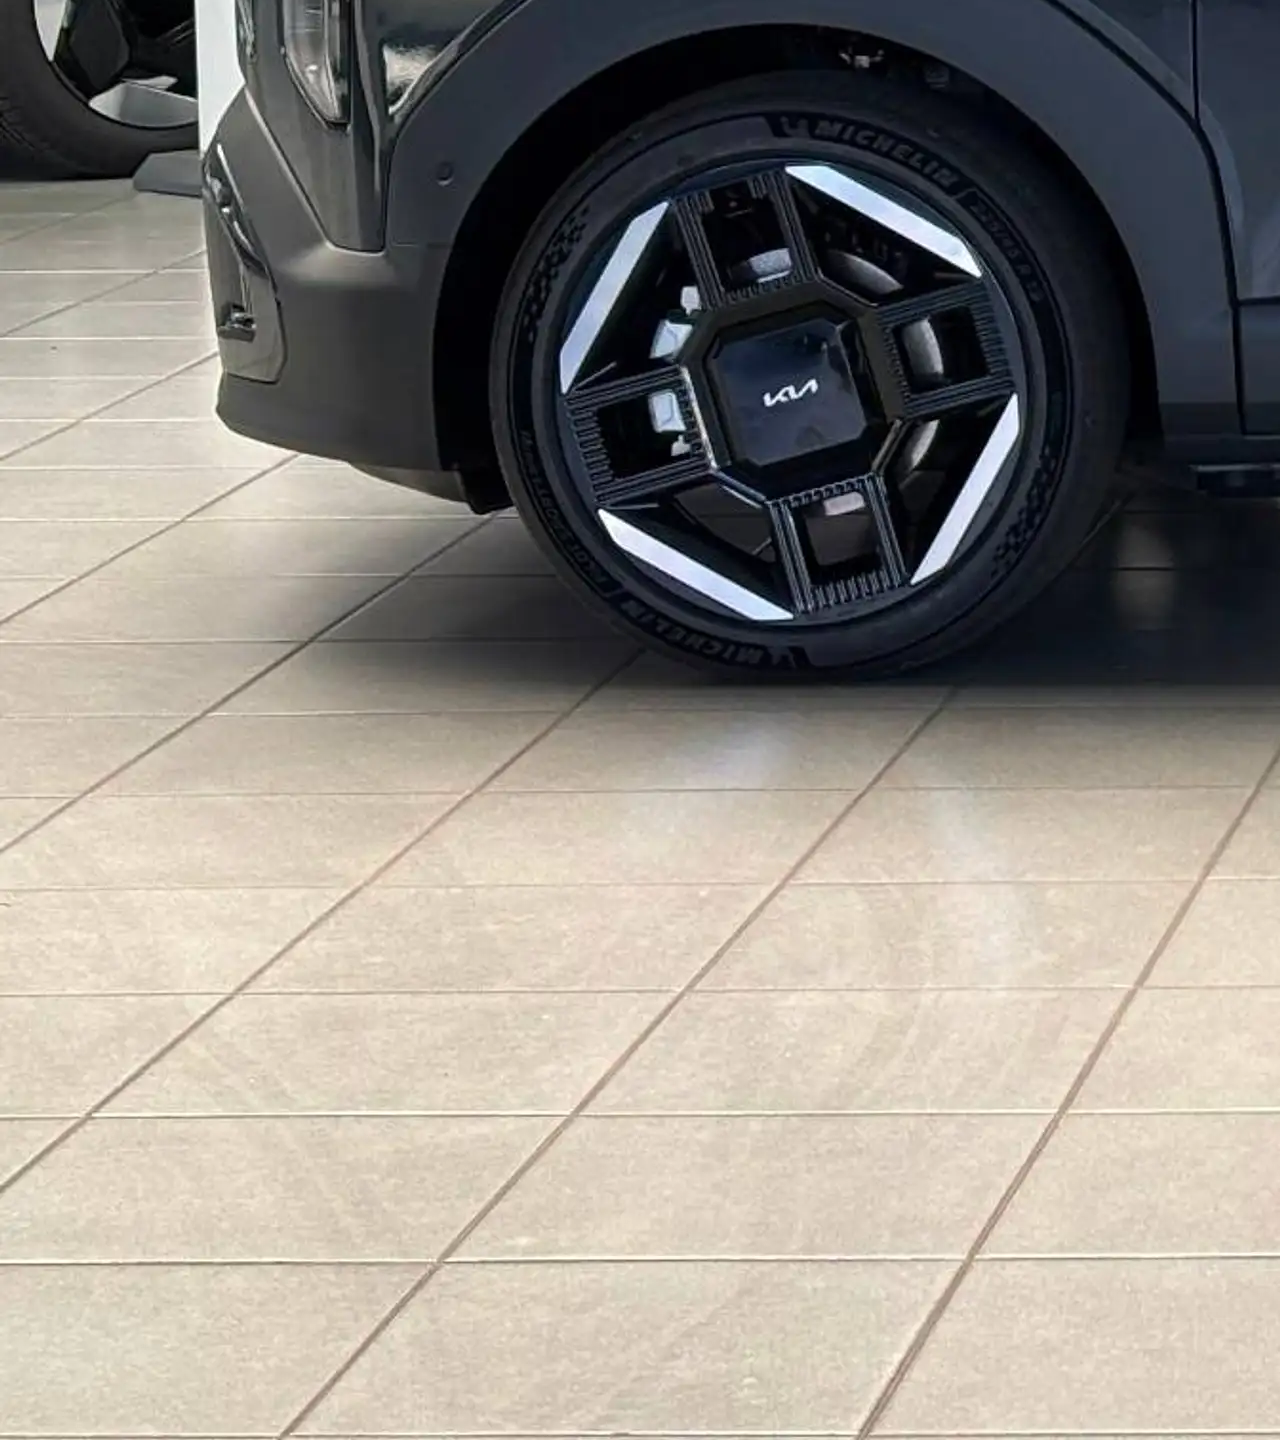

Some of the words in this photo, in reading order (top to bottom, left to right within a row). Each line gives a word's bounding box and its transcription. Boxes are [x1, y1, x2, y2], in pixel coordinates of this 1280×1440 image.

[815, 119, 960, 186] MICHELIN
[762, 378, 819, 407] KIA
[620, 600, 764, 664] MICHELIN
